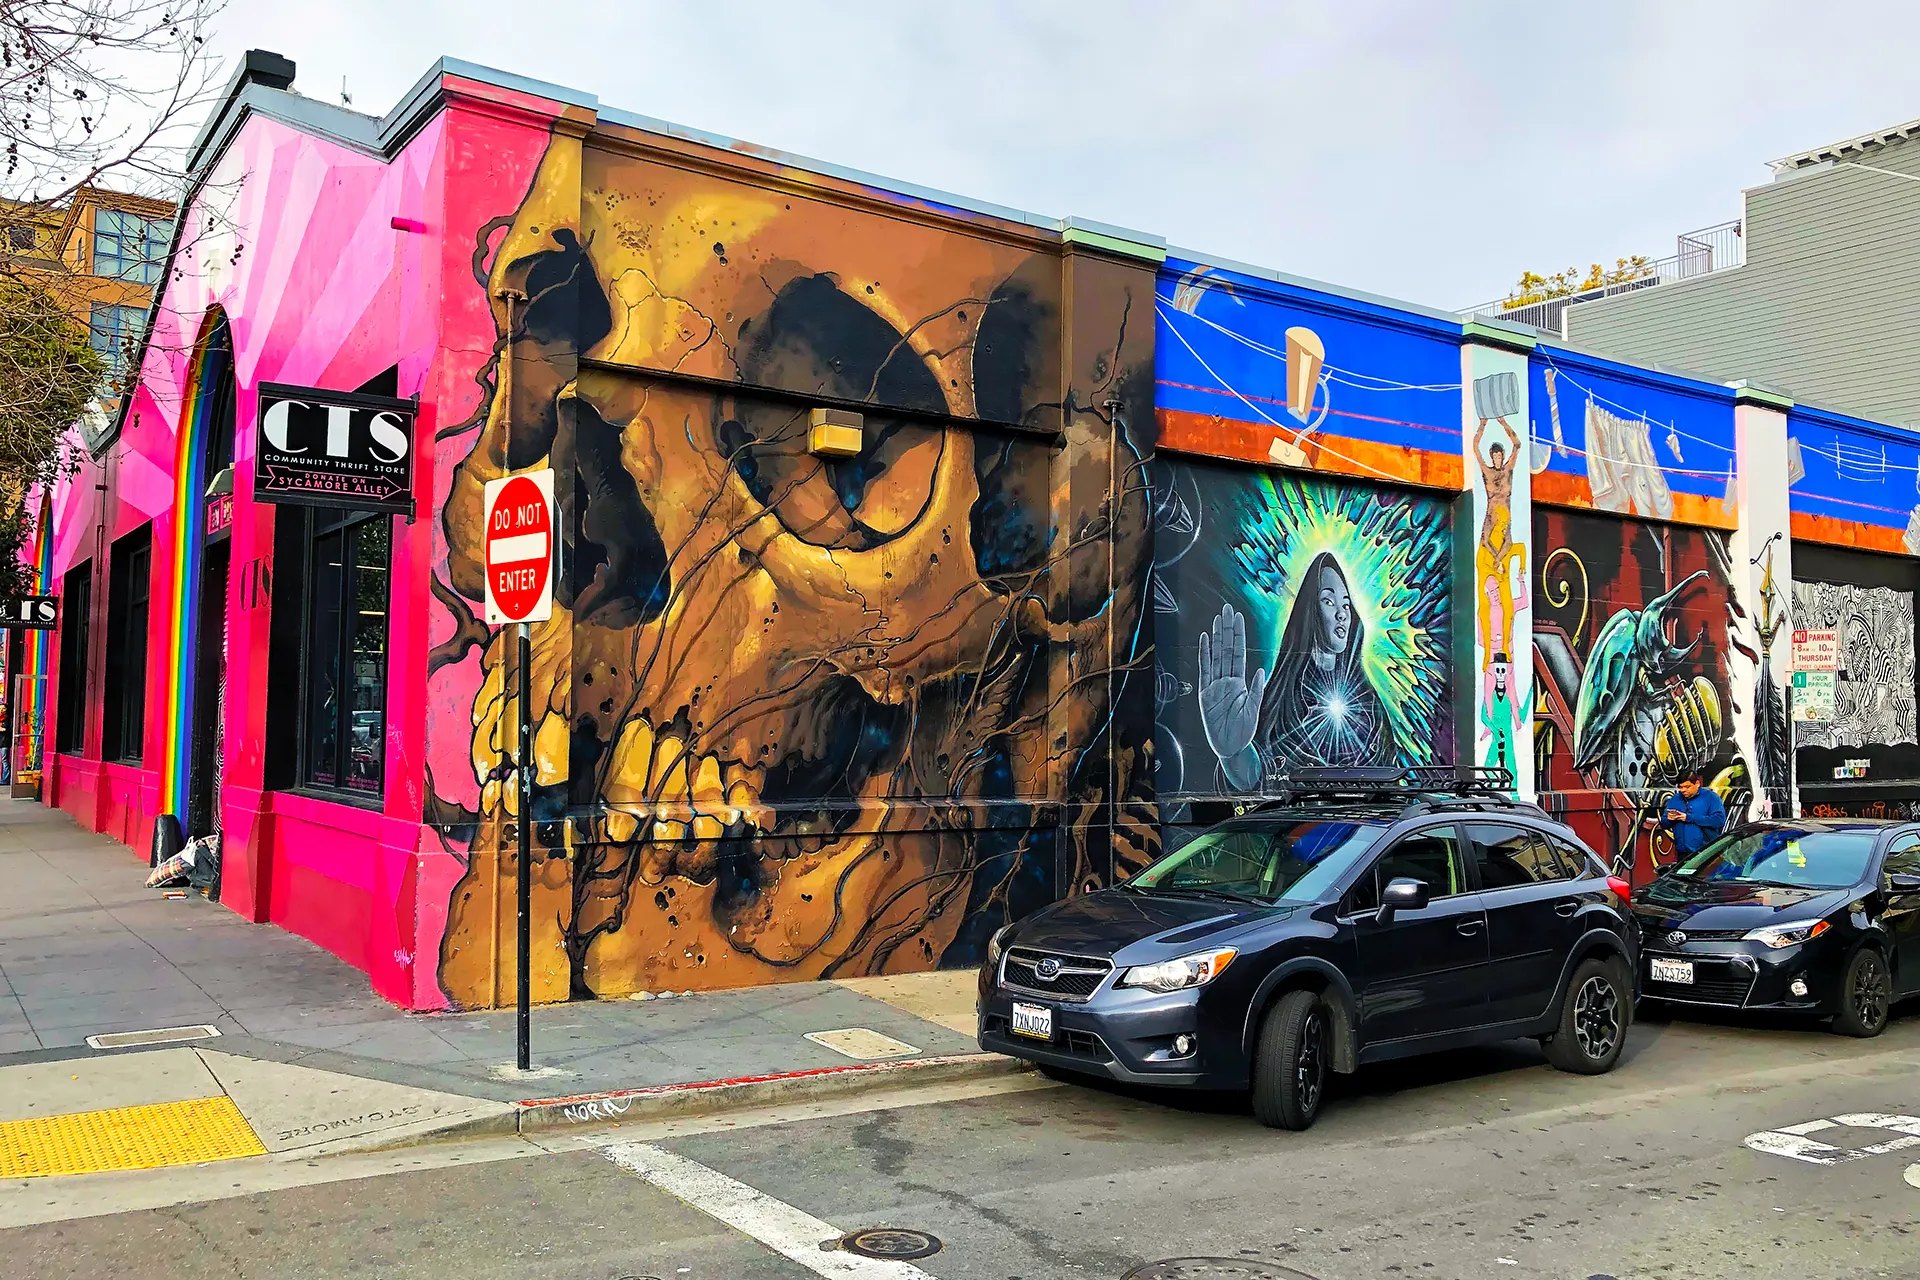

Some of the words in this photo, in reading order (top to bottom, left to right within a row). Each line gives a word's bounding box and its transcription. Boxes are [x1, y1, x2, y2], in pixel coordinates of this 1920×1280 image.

[263, 400, 408, 463] CTS
[264, 454, 330, 467] COMMUNITY
[335, 461, 369, 471] THRIFT
[374, 465, 405, 475] STORE
[279, 477, 349, 491] SYCAMORE
[355, 483, 390, 495] ALLEY
[305, 473, 346, 483] DONATE
[495, 508, 510, 531] DO
[517, 502, 542, 527] NOT
[240, 554, 272, 611] CTS
[499, 568, 536, 593] ENTER
[1794, 631, 1806, 642] NO
[1808, 633, 1836, 642] PARKING
[1798, 654, 1833, 662] THURSDAY
[1797, 675, 1802, 685] 1
[1653, 965, 1692, 981] 7NZS759
[1014, 1012, 1050, 1034] 7XNJ022
